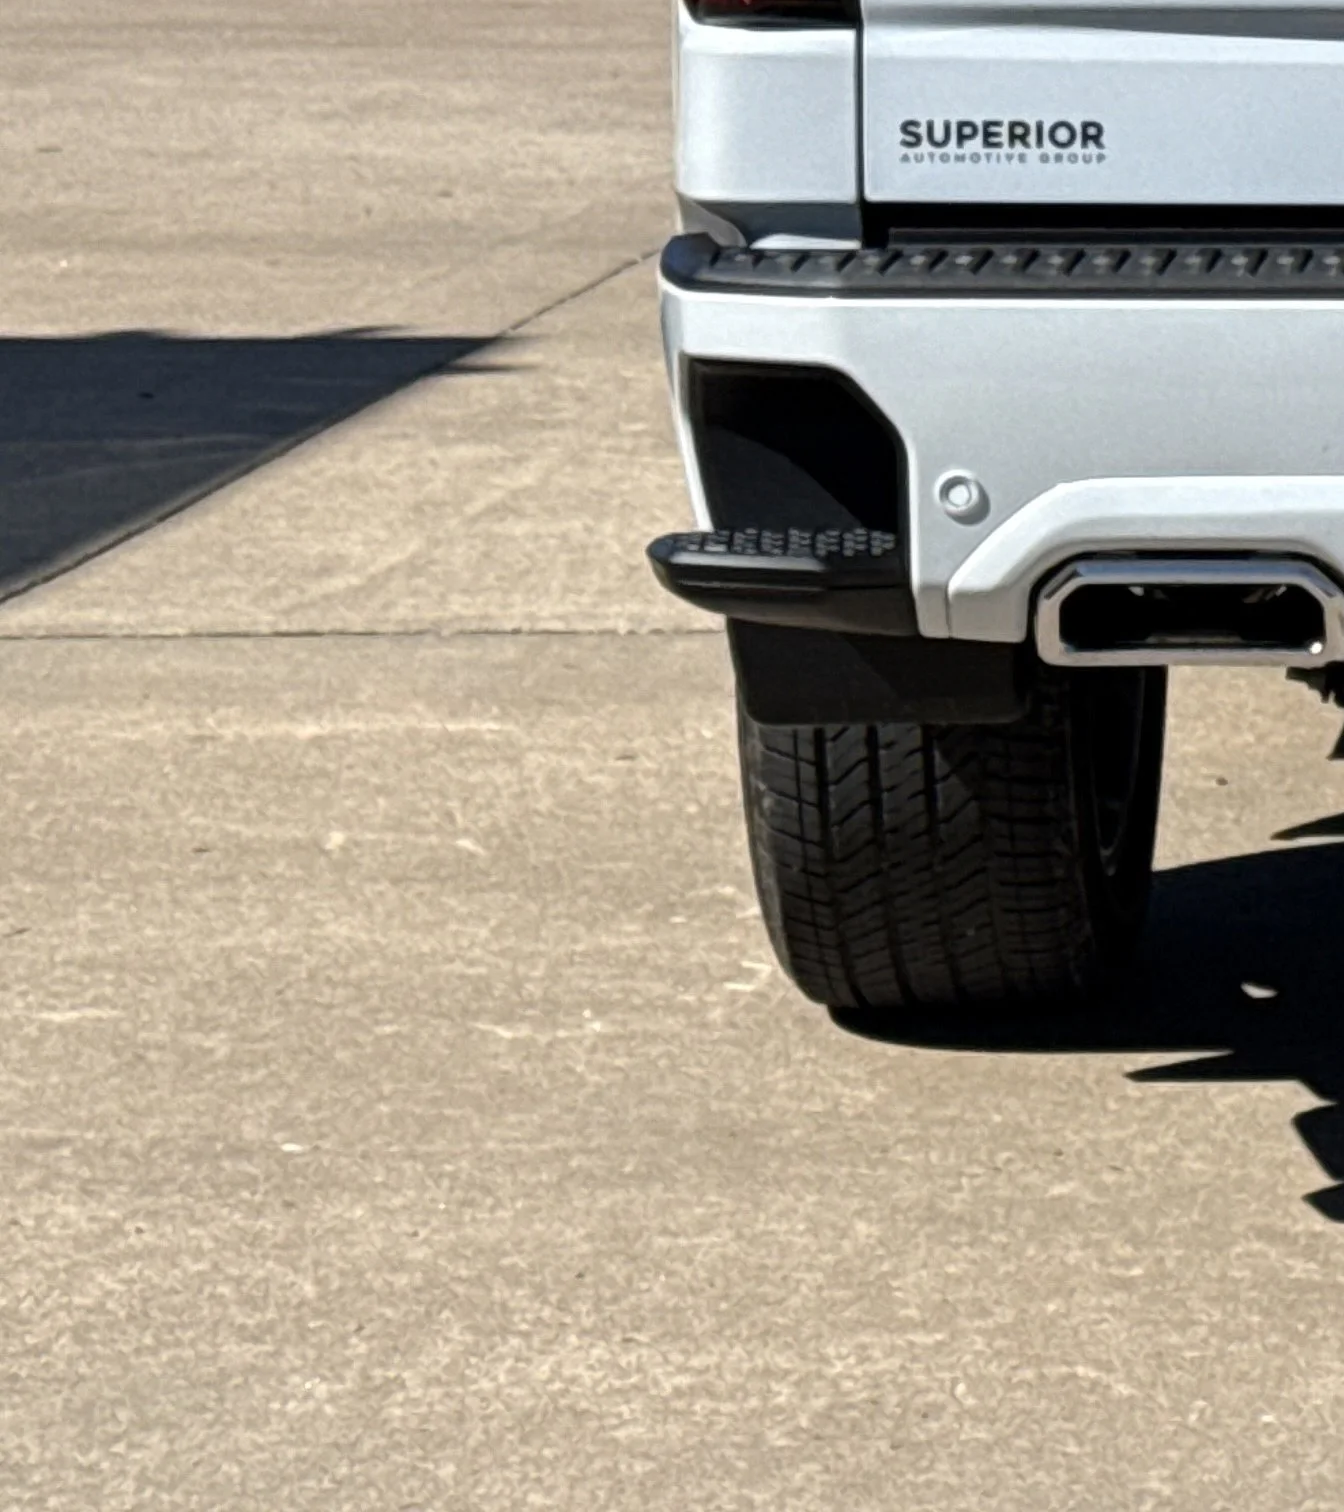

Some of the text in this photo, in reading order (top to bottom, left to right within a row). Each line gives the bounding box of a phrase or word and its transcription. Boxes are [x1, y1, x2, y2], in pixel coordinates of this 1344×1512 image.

[899, 119, 1105, 149] SUPERIOR
[899, 152, 1107, 164] AUTOMOTIVE GROUP
